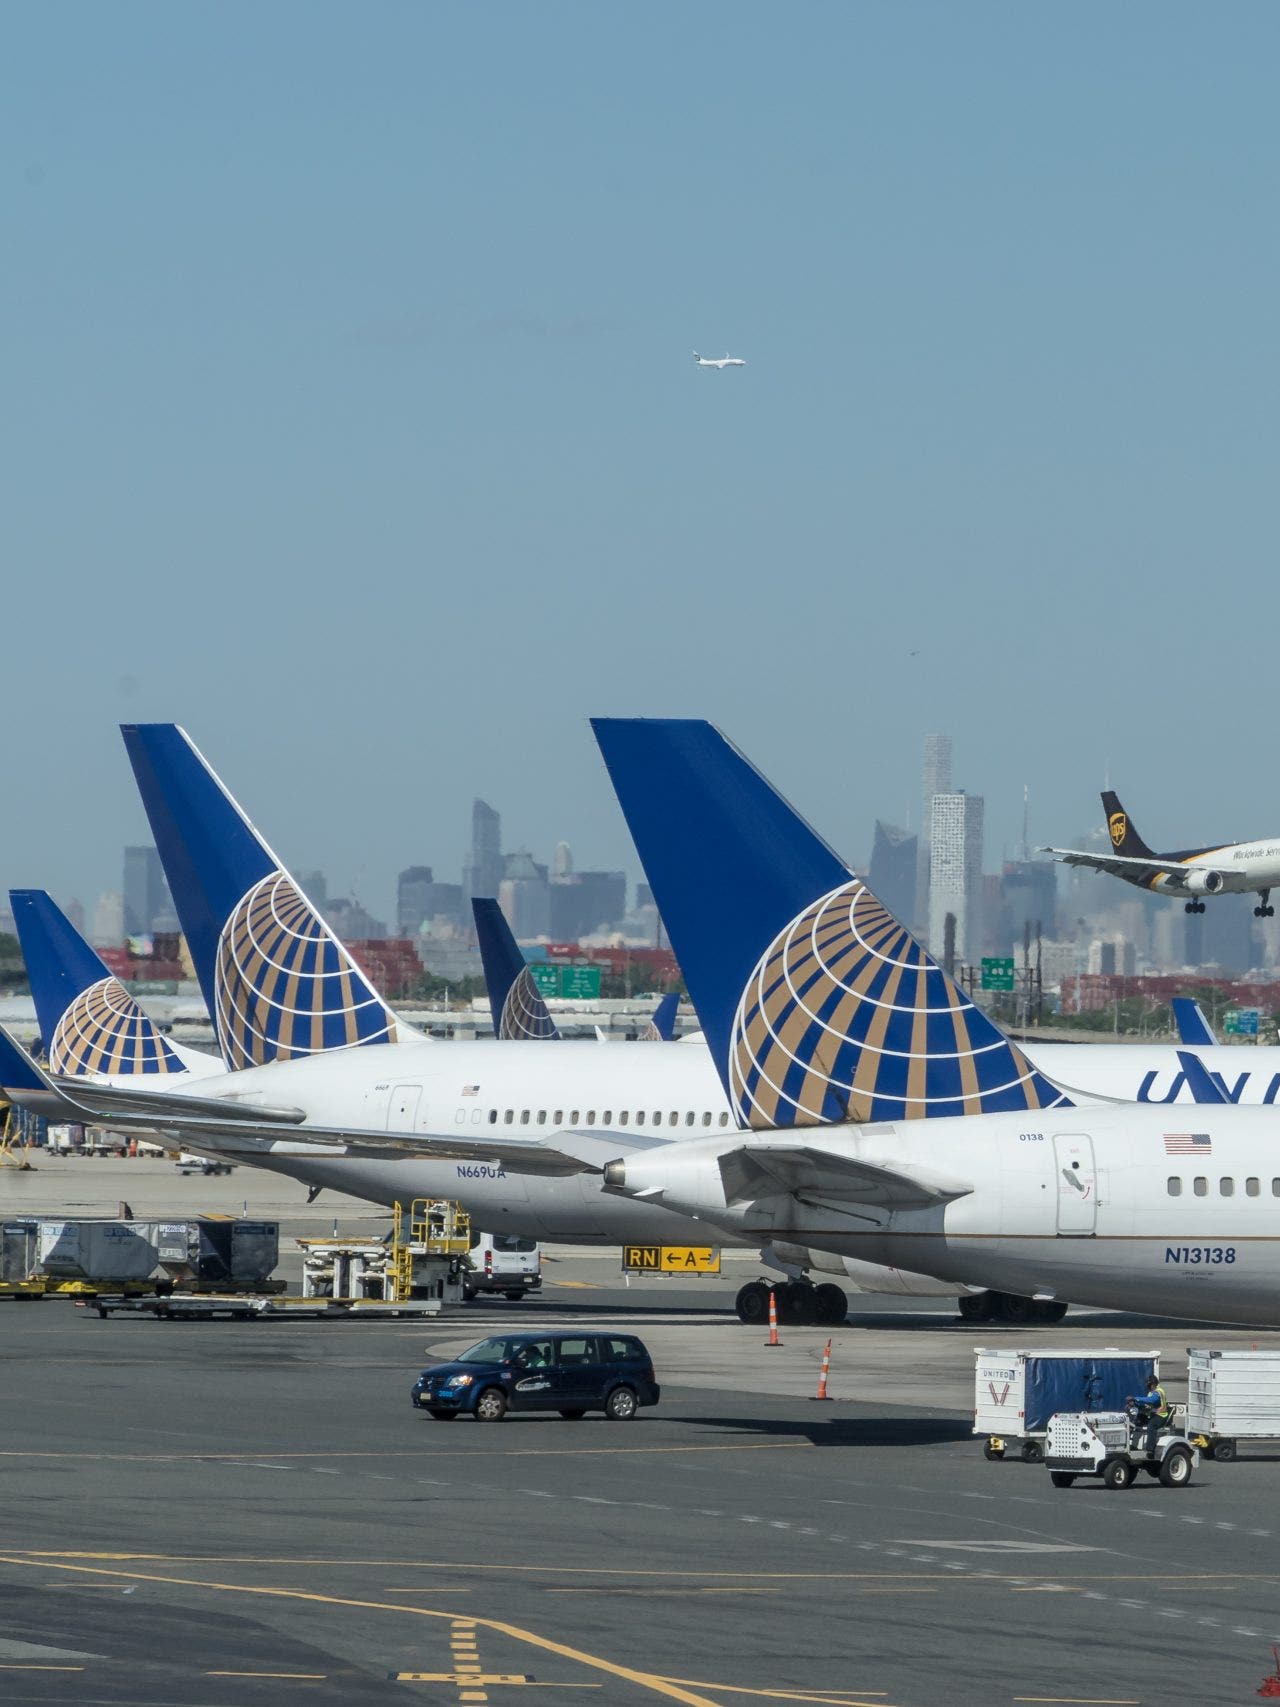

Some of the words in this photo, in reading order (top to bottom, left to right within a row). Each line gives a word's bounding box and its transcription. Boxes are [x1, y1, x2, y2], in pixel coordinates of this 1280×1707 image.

[1019, 1133, 1044, 1142] 0138
[629, 1249, 655, 1266] RN
[685, 1251, 697, 1266] A
[1164, 1247, 1236, 1264] N13138
[983, 1370, 1009, 1378] UNITED
